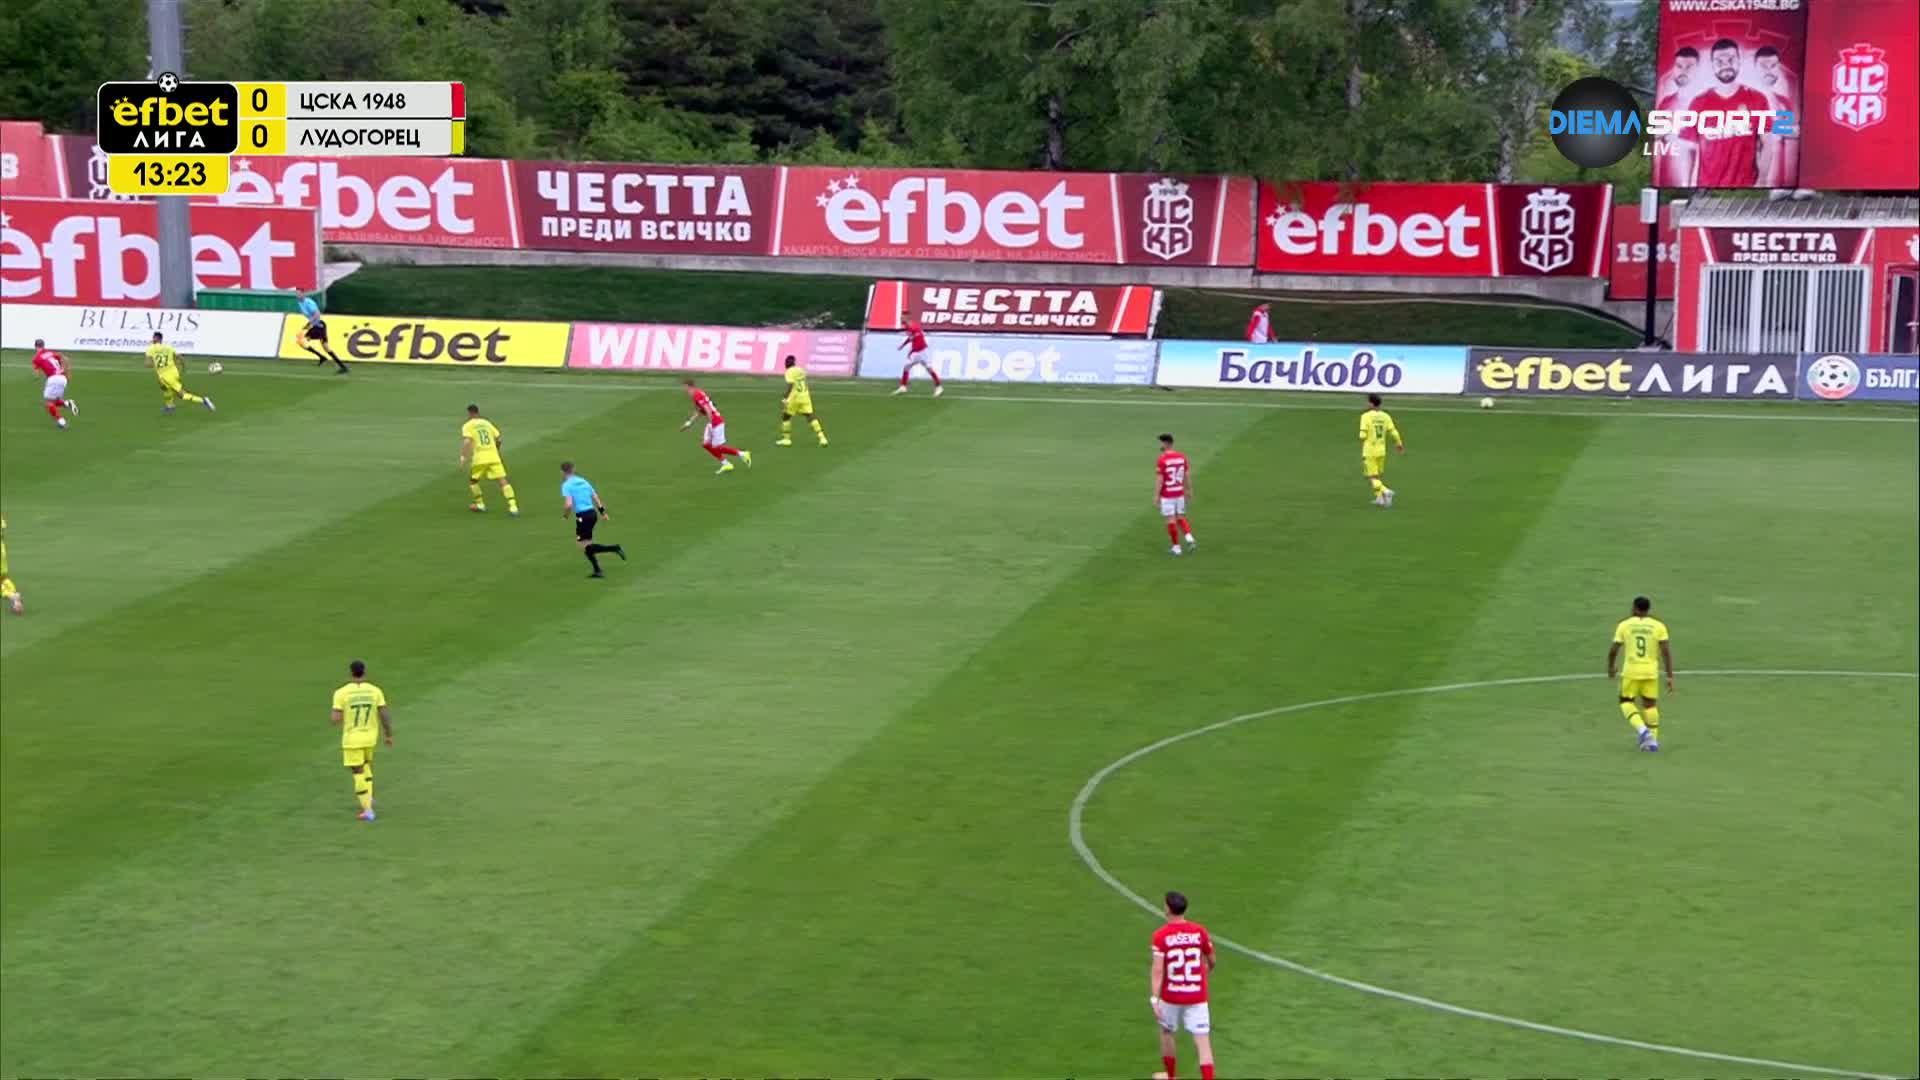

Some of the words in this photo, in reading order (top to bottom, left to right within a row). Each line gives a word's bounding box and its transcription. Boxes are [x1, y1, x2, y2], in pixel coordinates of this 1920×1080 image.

[218, 161, 475, 233] efbet
[537, 170, 752, 216] ЧЕСТТА
[541, 215, 632, 243] ПРЕДИ
[641, 220, 752, 244] ВСИЧКО
[822, 177, 1086, 249] efbet
[1271, 202, 1482, 259] efbet
[1, 215, 296, 305] efbet
[1732, 232, 1837, 252] ЧЕСТТА
[922, 286, 1098, 314] ЧЕСТТА
[80, 308, 200, 331] BULAPIS
[921, 311, 995, 326] ПРЕДИ
[1003, 312, 1097, 327] ВСИЧКО
[345, 322, 511, 366] efbet
[587, 327, 791, 373] WINBET
[1219, 348, 1404, 392] Бачково
[1478, 356, 1633, 392] efbet
[1637, 364, 1789, 395] ЛИГА
[1165, 466, 1185, 486] 34
[1635, 636, 1647, 657] 9
[350, 704, 372, 728] 77
[1167, 948, 1202, 982] 22
